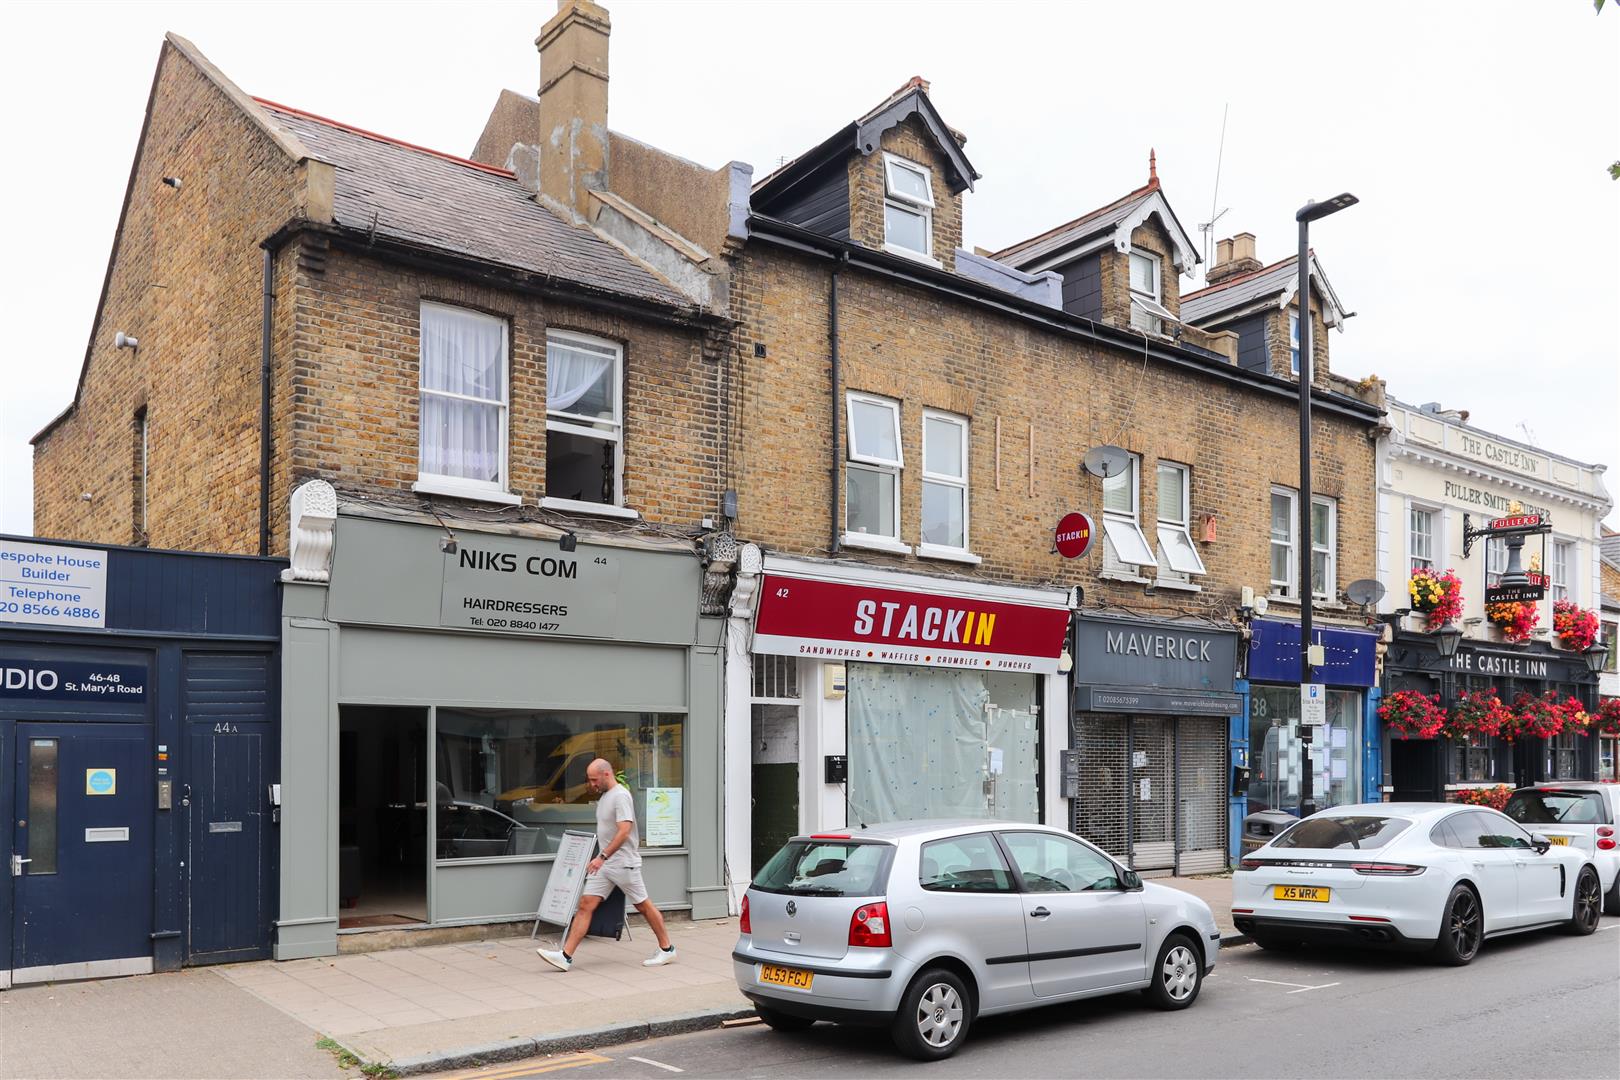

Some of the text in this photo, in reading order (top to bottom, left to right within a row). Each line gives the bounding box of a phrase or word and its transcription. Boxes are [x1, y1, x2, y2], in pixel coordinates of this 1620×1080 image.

[1462, 435, 1481, 456] THE
[1485, 443, 1519, 468] CASTLE
[1056, 529, 1089, 543] STACKIN
[56, 555, 101, 569] House
[459, 549, 577, 579] NIKS COM
[593, 557, 607, 565] 44
[21, 567, 71, 581] Builder
[9, 586, 81, 602] Telephone
[776, 588, 789, 598] 42
[22, 604, 60, 616] 8566
[63, 606, 100, 619] 4886
[463, 597, 568, 616] HAIRDRESSERS
[486, 618, 507, 628] 020
[510, 620, 537, 630] 8840
[539, 622, 560, 631] 1477
[854, 599, 997, 646] STACKIN
[1106, 630, 1211, 662] MAVERICK
[799, 645, 1032, 670] SANDWICHES WAFFLES CRUMBLES PUNCHES
[1478, 655, 1520, 674] CASTLE
[1526, 660, 1547, 676] INN
[89, 673, 120, 683] 46-48
[65, 682, 143, 694] St. Mary's Road
[1252, 698, 1267, 717] 38
[1284, 887, 1318, 899] X5 WRK
[763, 967, 809, 986] GL53 FGJ
